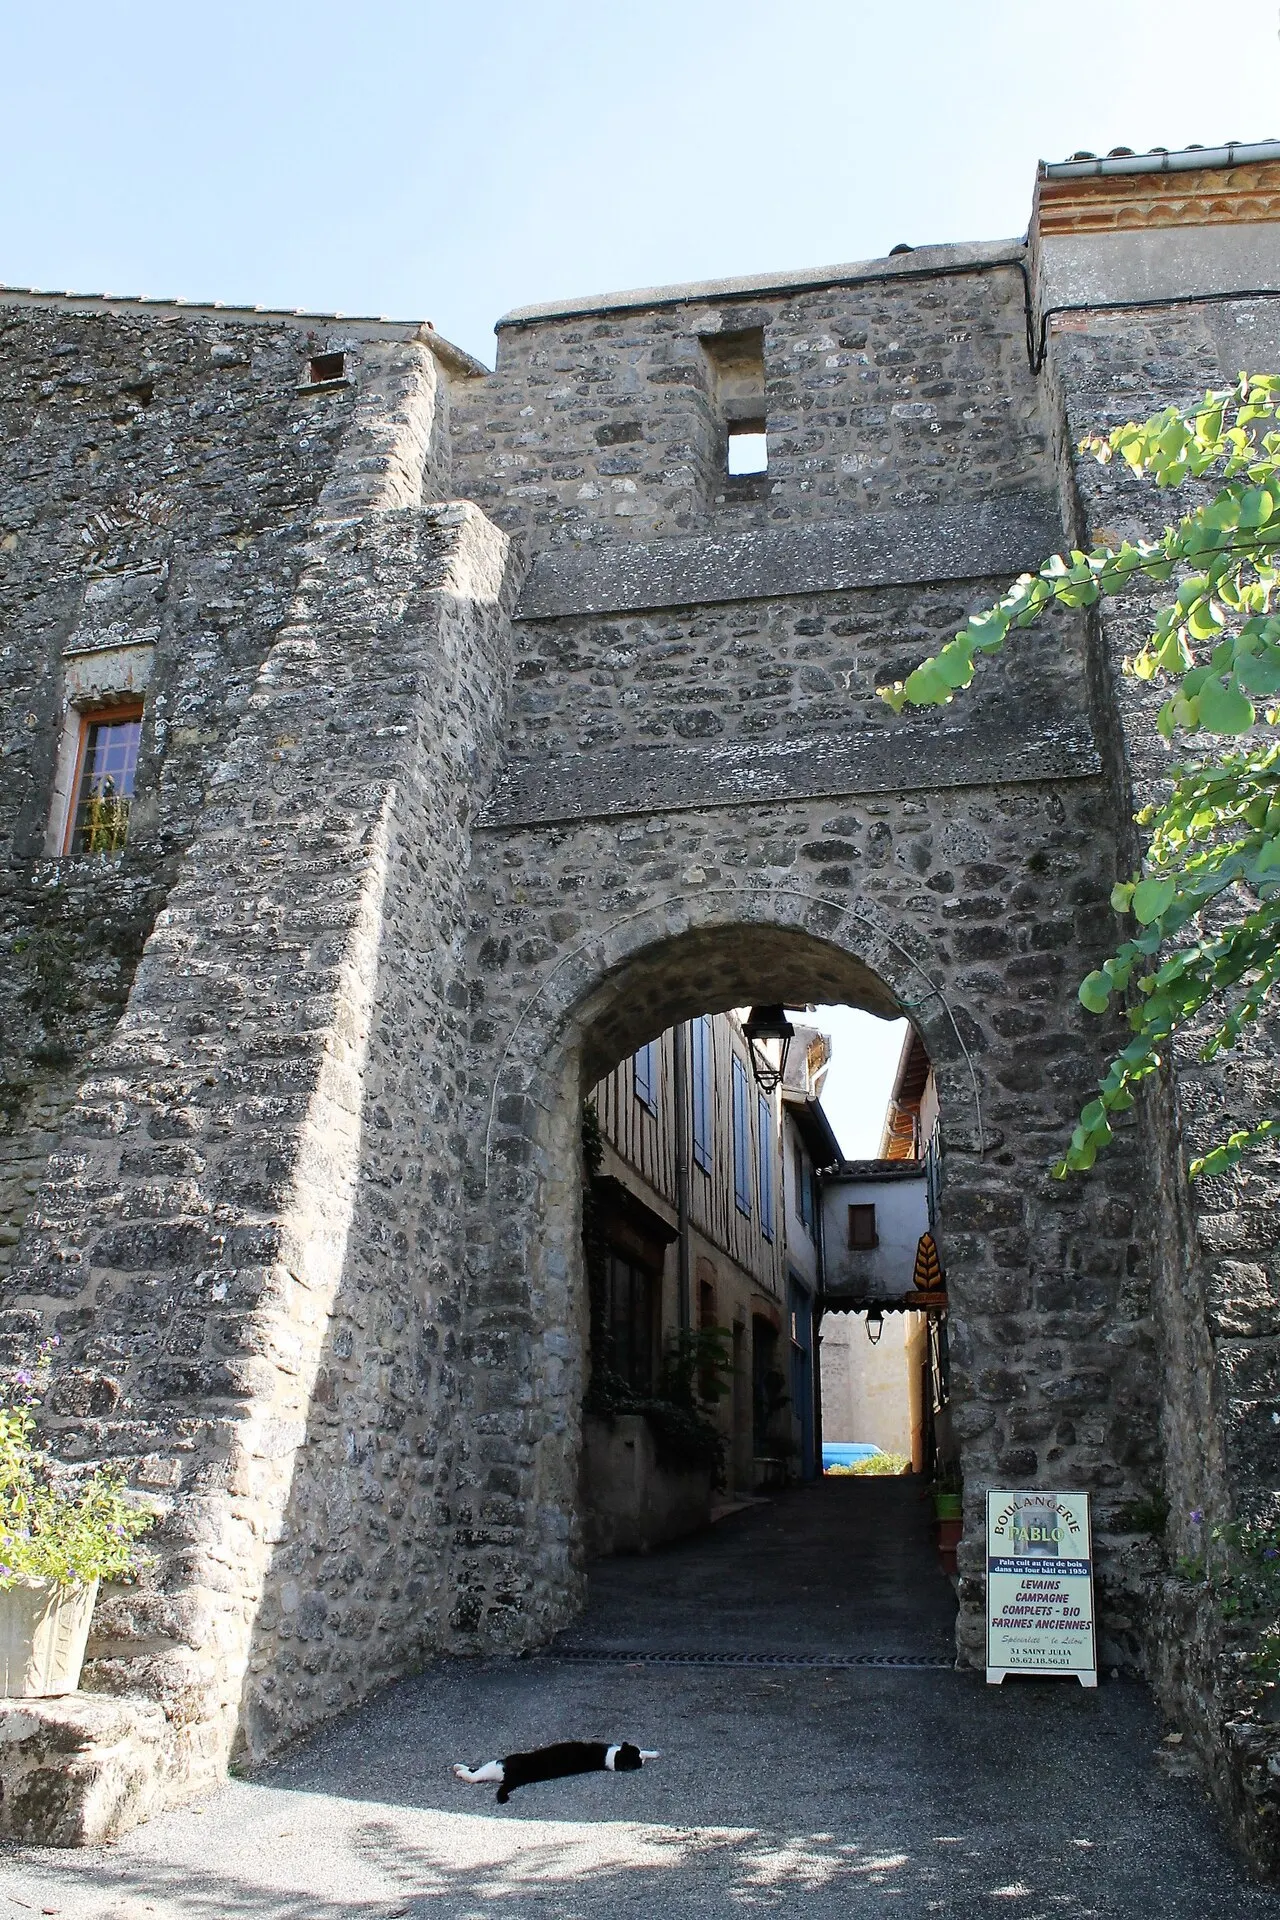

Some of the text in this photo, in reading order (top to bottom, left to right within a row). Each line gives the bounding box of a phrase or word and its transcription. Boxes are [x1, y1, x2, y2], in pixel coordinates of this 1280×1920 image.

[994, 1496, 1081, 1535] BOULANGERIE
[1008, 1526, 1065, 1542] PABLO
[1067, 1560, 1083, 1568] bois
[1025, 1566, 1040, 1574] four
[1021, 1580, 1061, 1590] LEVAINS
[1016, 1593, 1069, 1603] CAMPAGNE
[1002, 1605, 1053, 1616] COMPLETS
[1062, 1607, 1080, 1617] BIO
[992, 1618, 1092, 1630] FARINES ANCIENNES
[1022, 1648, 1046, 1656] SAINT
